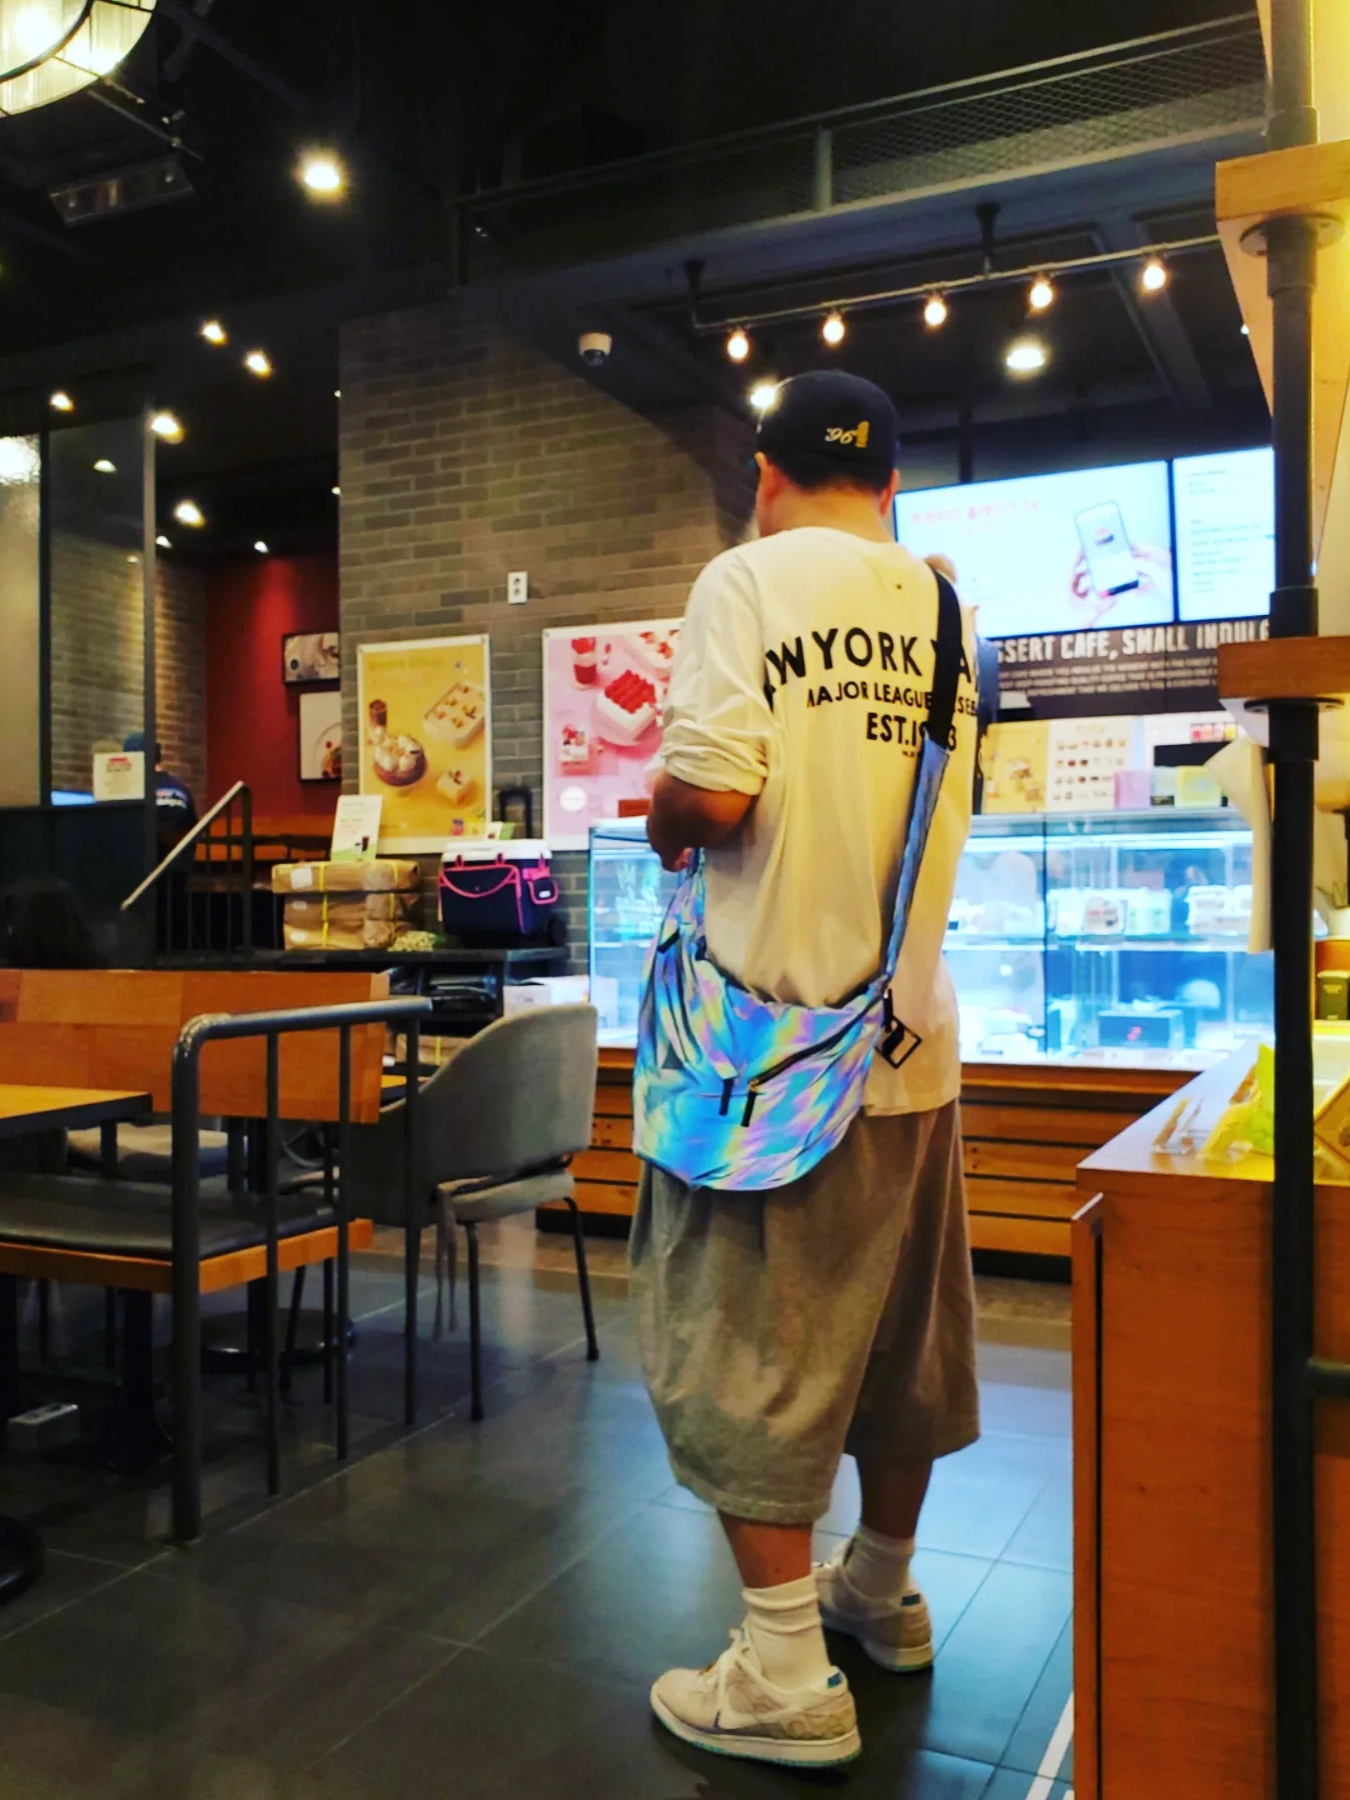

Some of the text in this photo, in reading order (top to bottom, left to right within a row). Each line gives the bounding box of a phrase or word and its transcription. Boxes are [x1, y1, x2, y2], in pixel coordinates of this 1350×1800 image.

[811, 627, 923, 677] YORK
[1061, 631, 1119, 661] CAFE,
[1122, 624, 1189, 655] SMALL
[874, 682, 933, 711] LEAGUE
